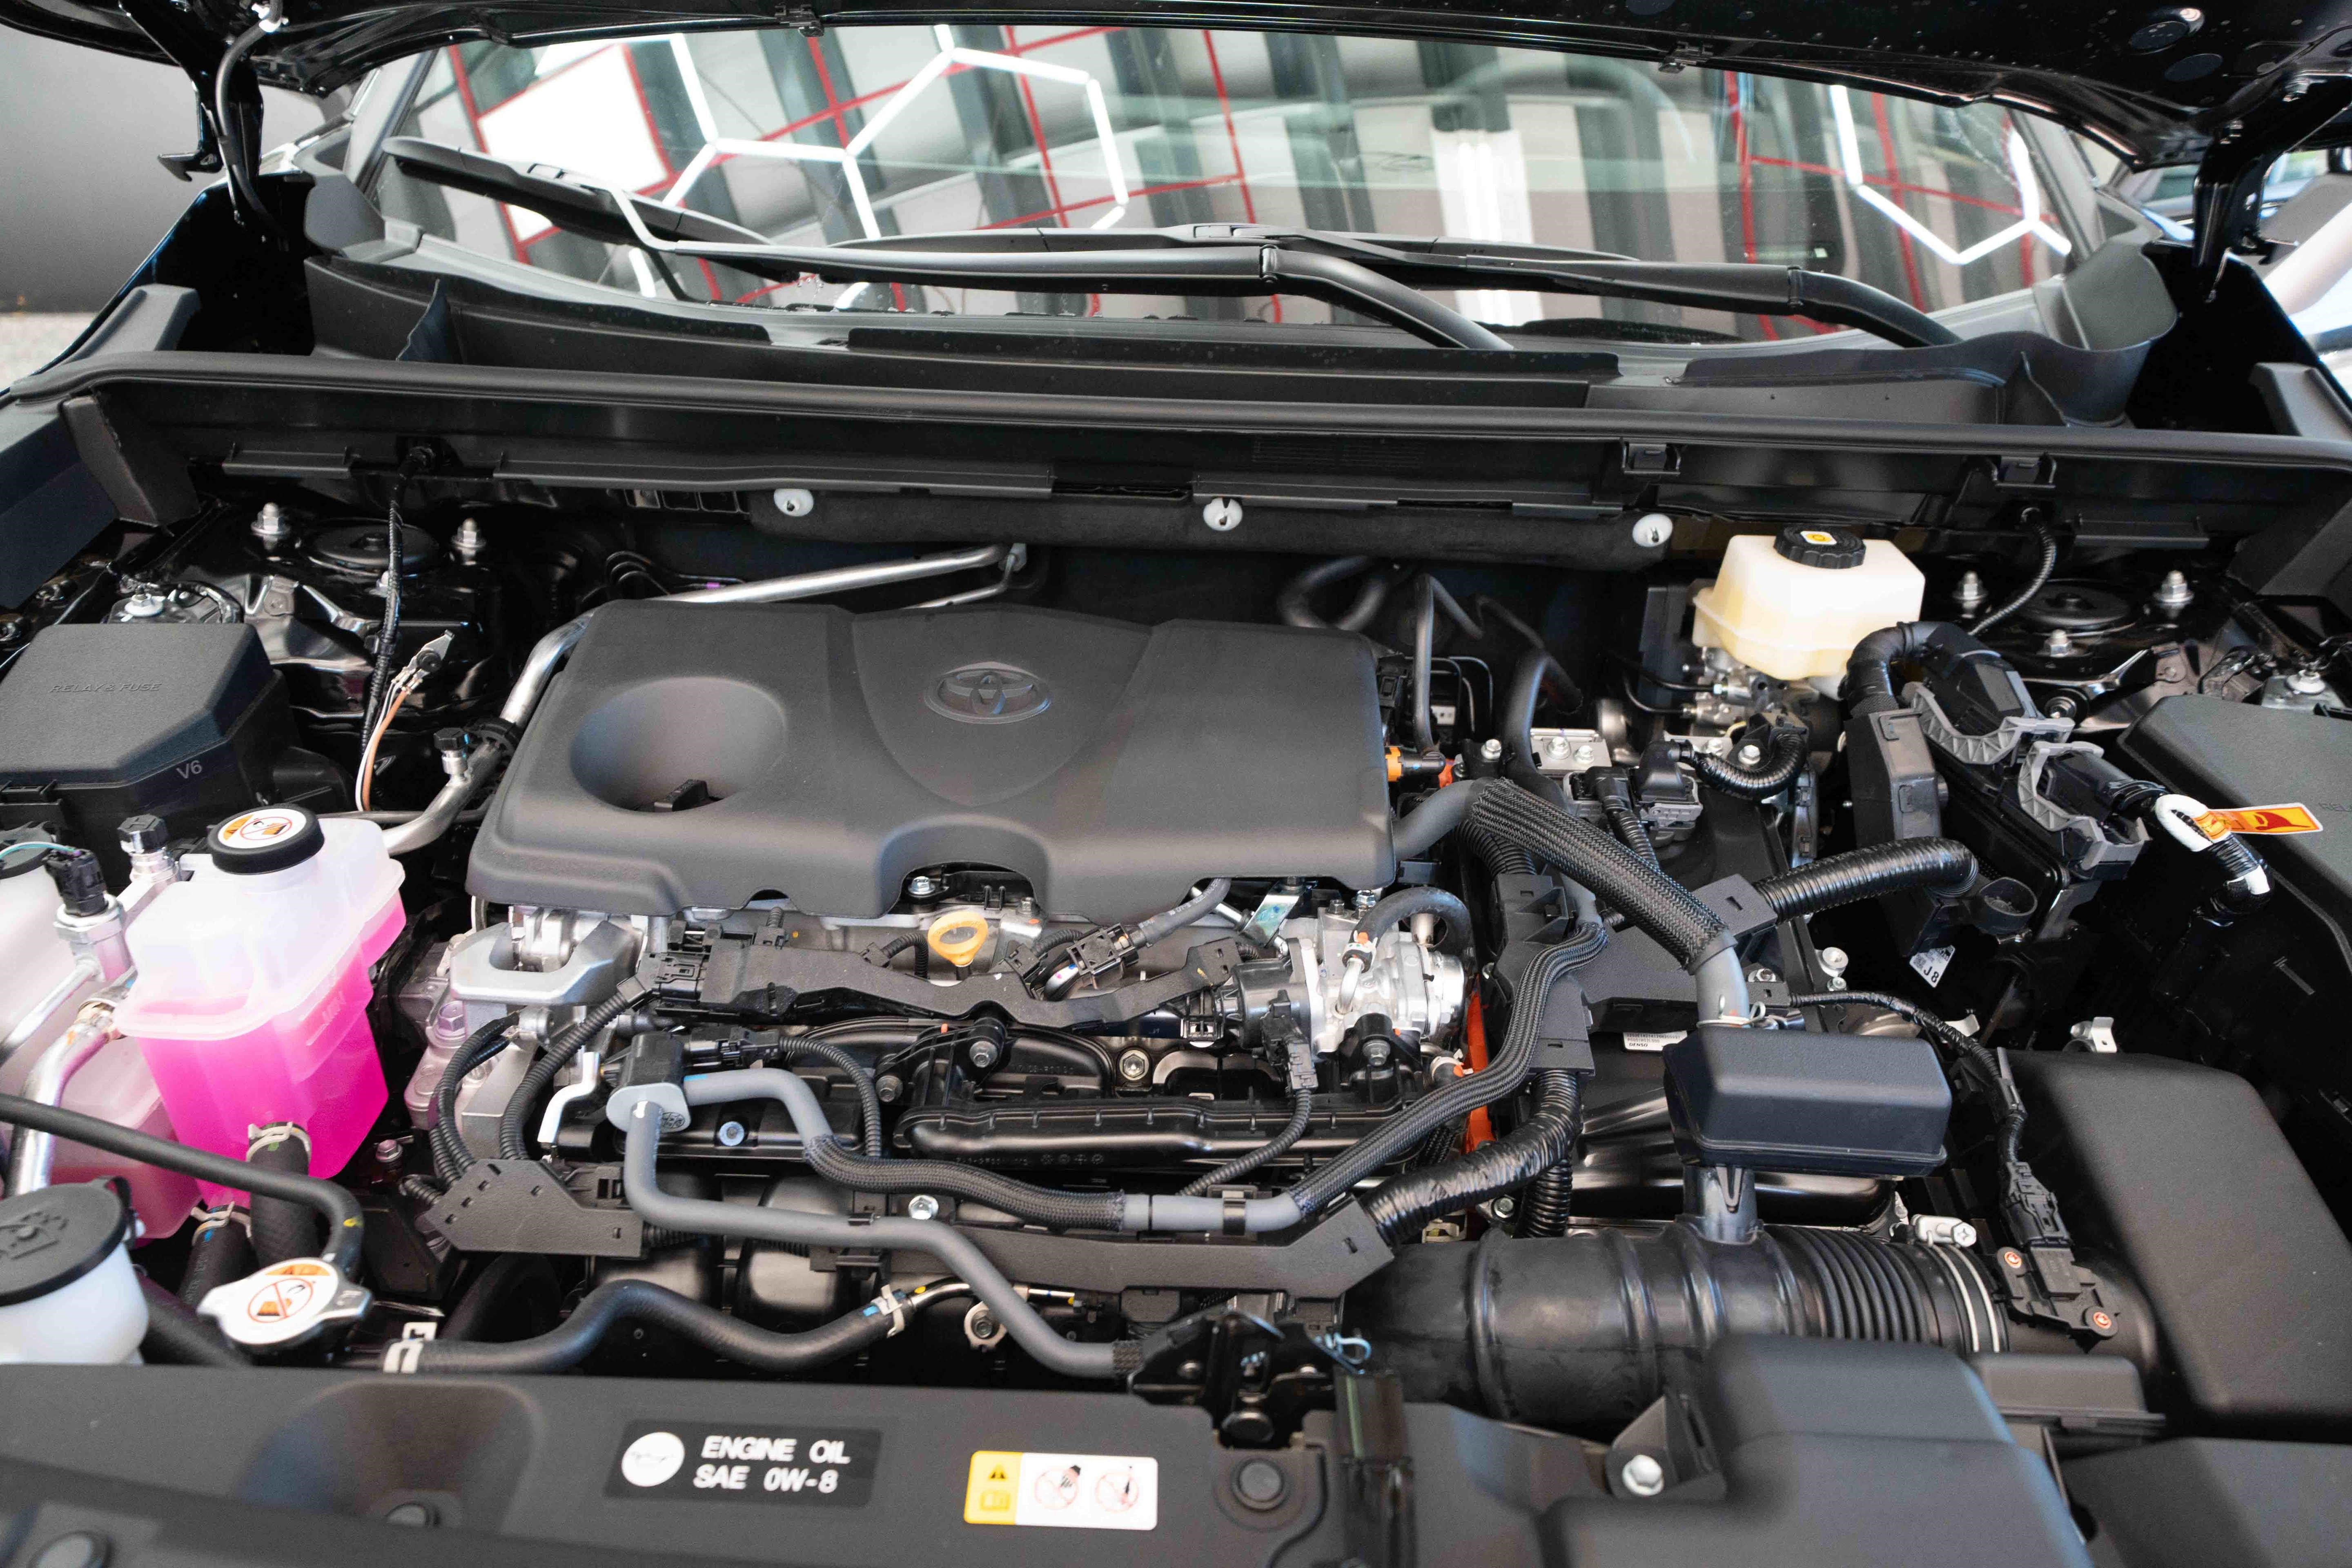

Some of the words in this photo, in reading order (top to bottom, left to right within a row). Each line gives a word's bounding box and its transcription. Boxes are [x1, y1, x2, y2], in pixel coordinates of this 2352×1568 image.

[49, 683, 105, 693] RELAY
[119, 683, 162, 692] FUSE
[176, 760, 203, 779] V6
[701, 1434, 797, 1462] ENGINE
[808, 1439, 851, 1465] OIL
[693, 1464, 750, 1490] SAE
[763, 1467, 839, 1494] 0W-8
